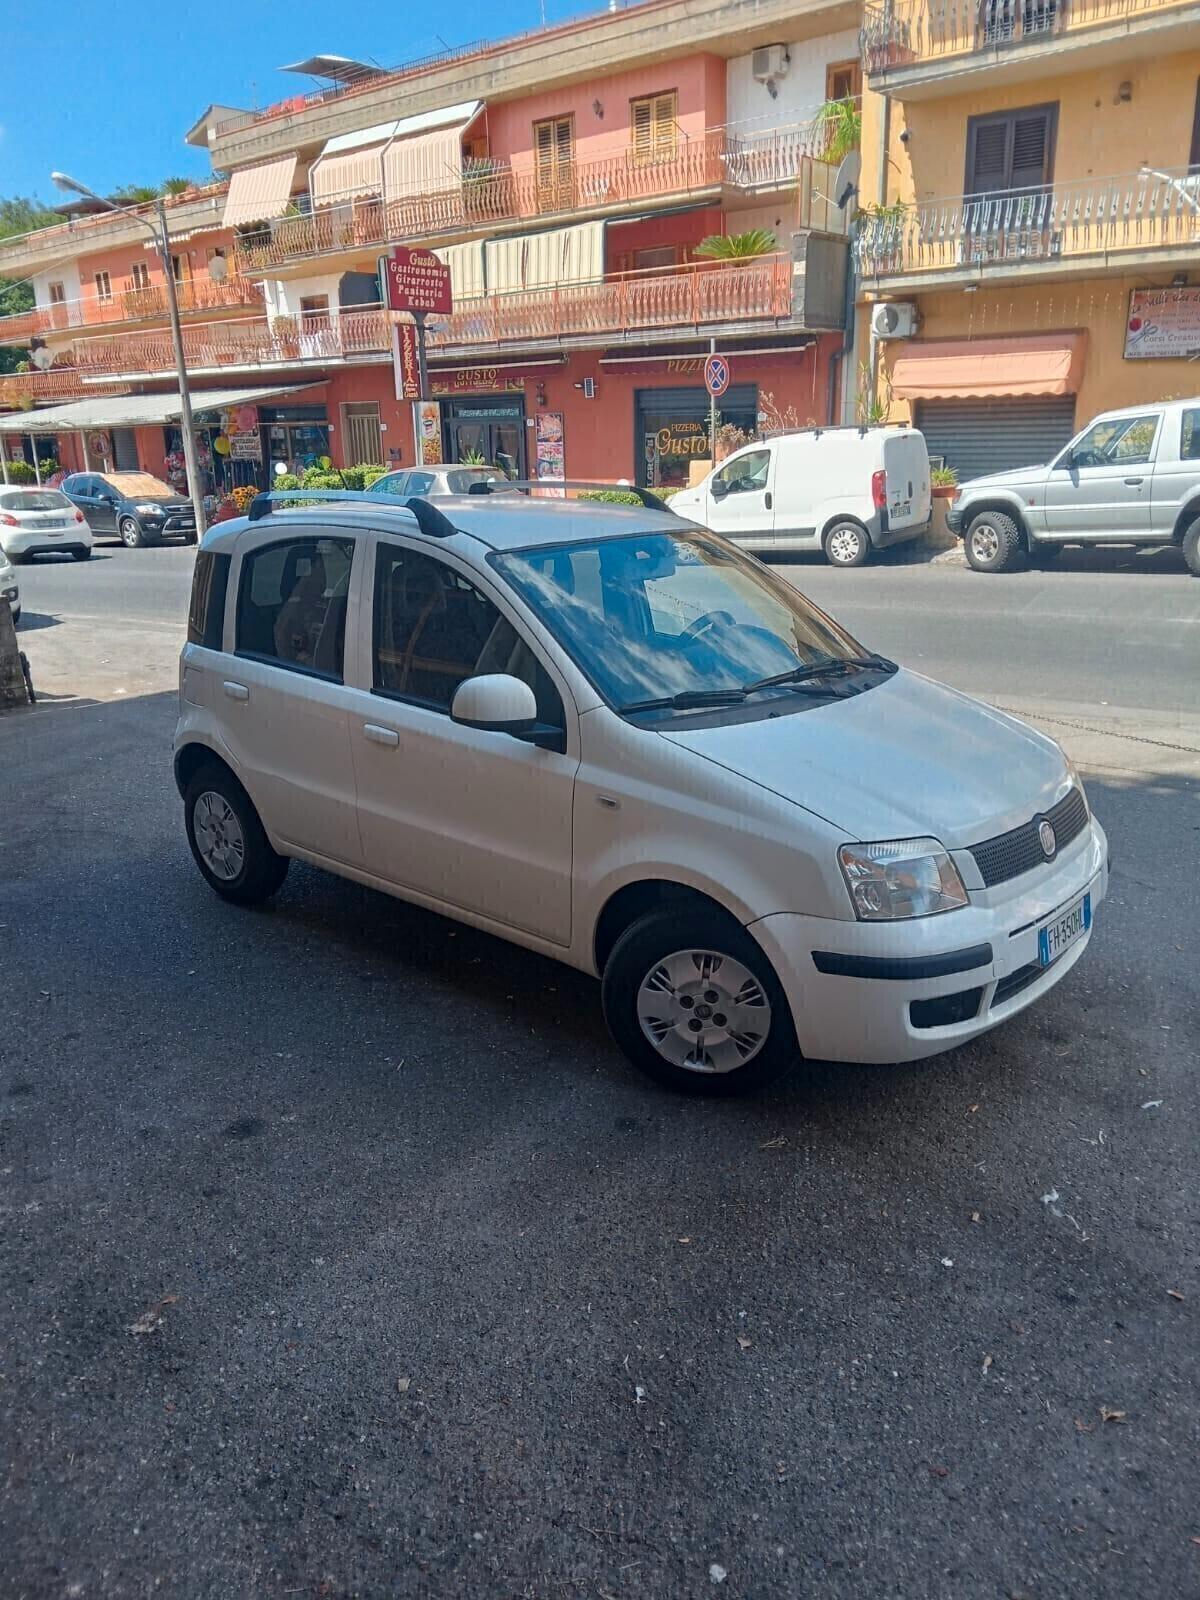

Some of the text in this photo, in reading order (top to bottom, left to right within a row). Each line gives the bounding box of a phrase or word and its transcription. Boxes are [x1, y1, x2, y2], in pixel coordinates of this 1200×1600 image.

[390, 262, 448, 278] Gastronomia
[395, 273, 443, 288] Girarrosto
[398, 284, 443, 298] Panineria
[408, 296, 435, 308] Kebab
[402, 325, 415, 383] PIZZERIA
[671, 423, 703, 432] PIZZERIA
